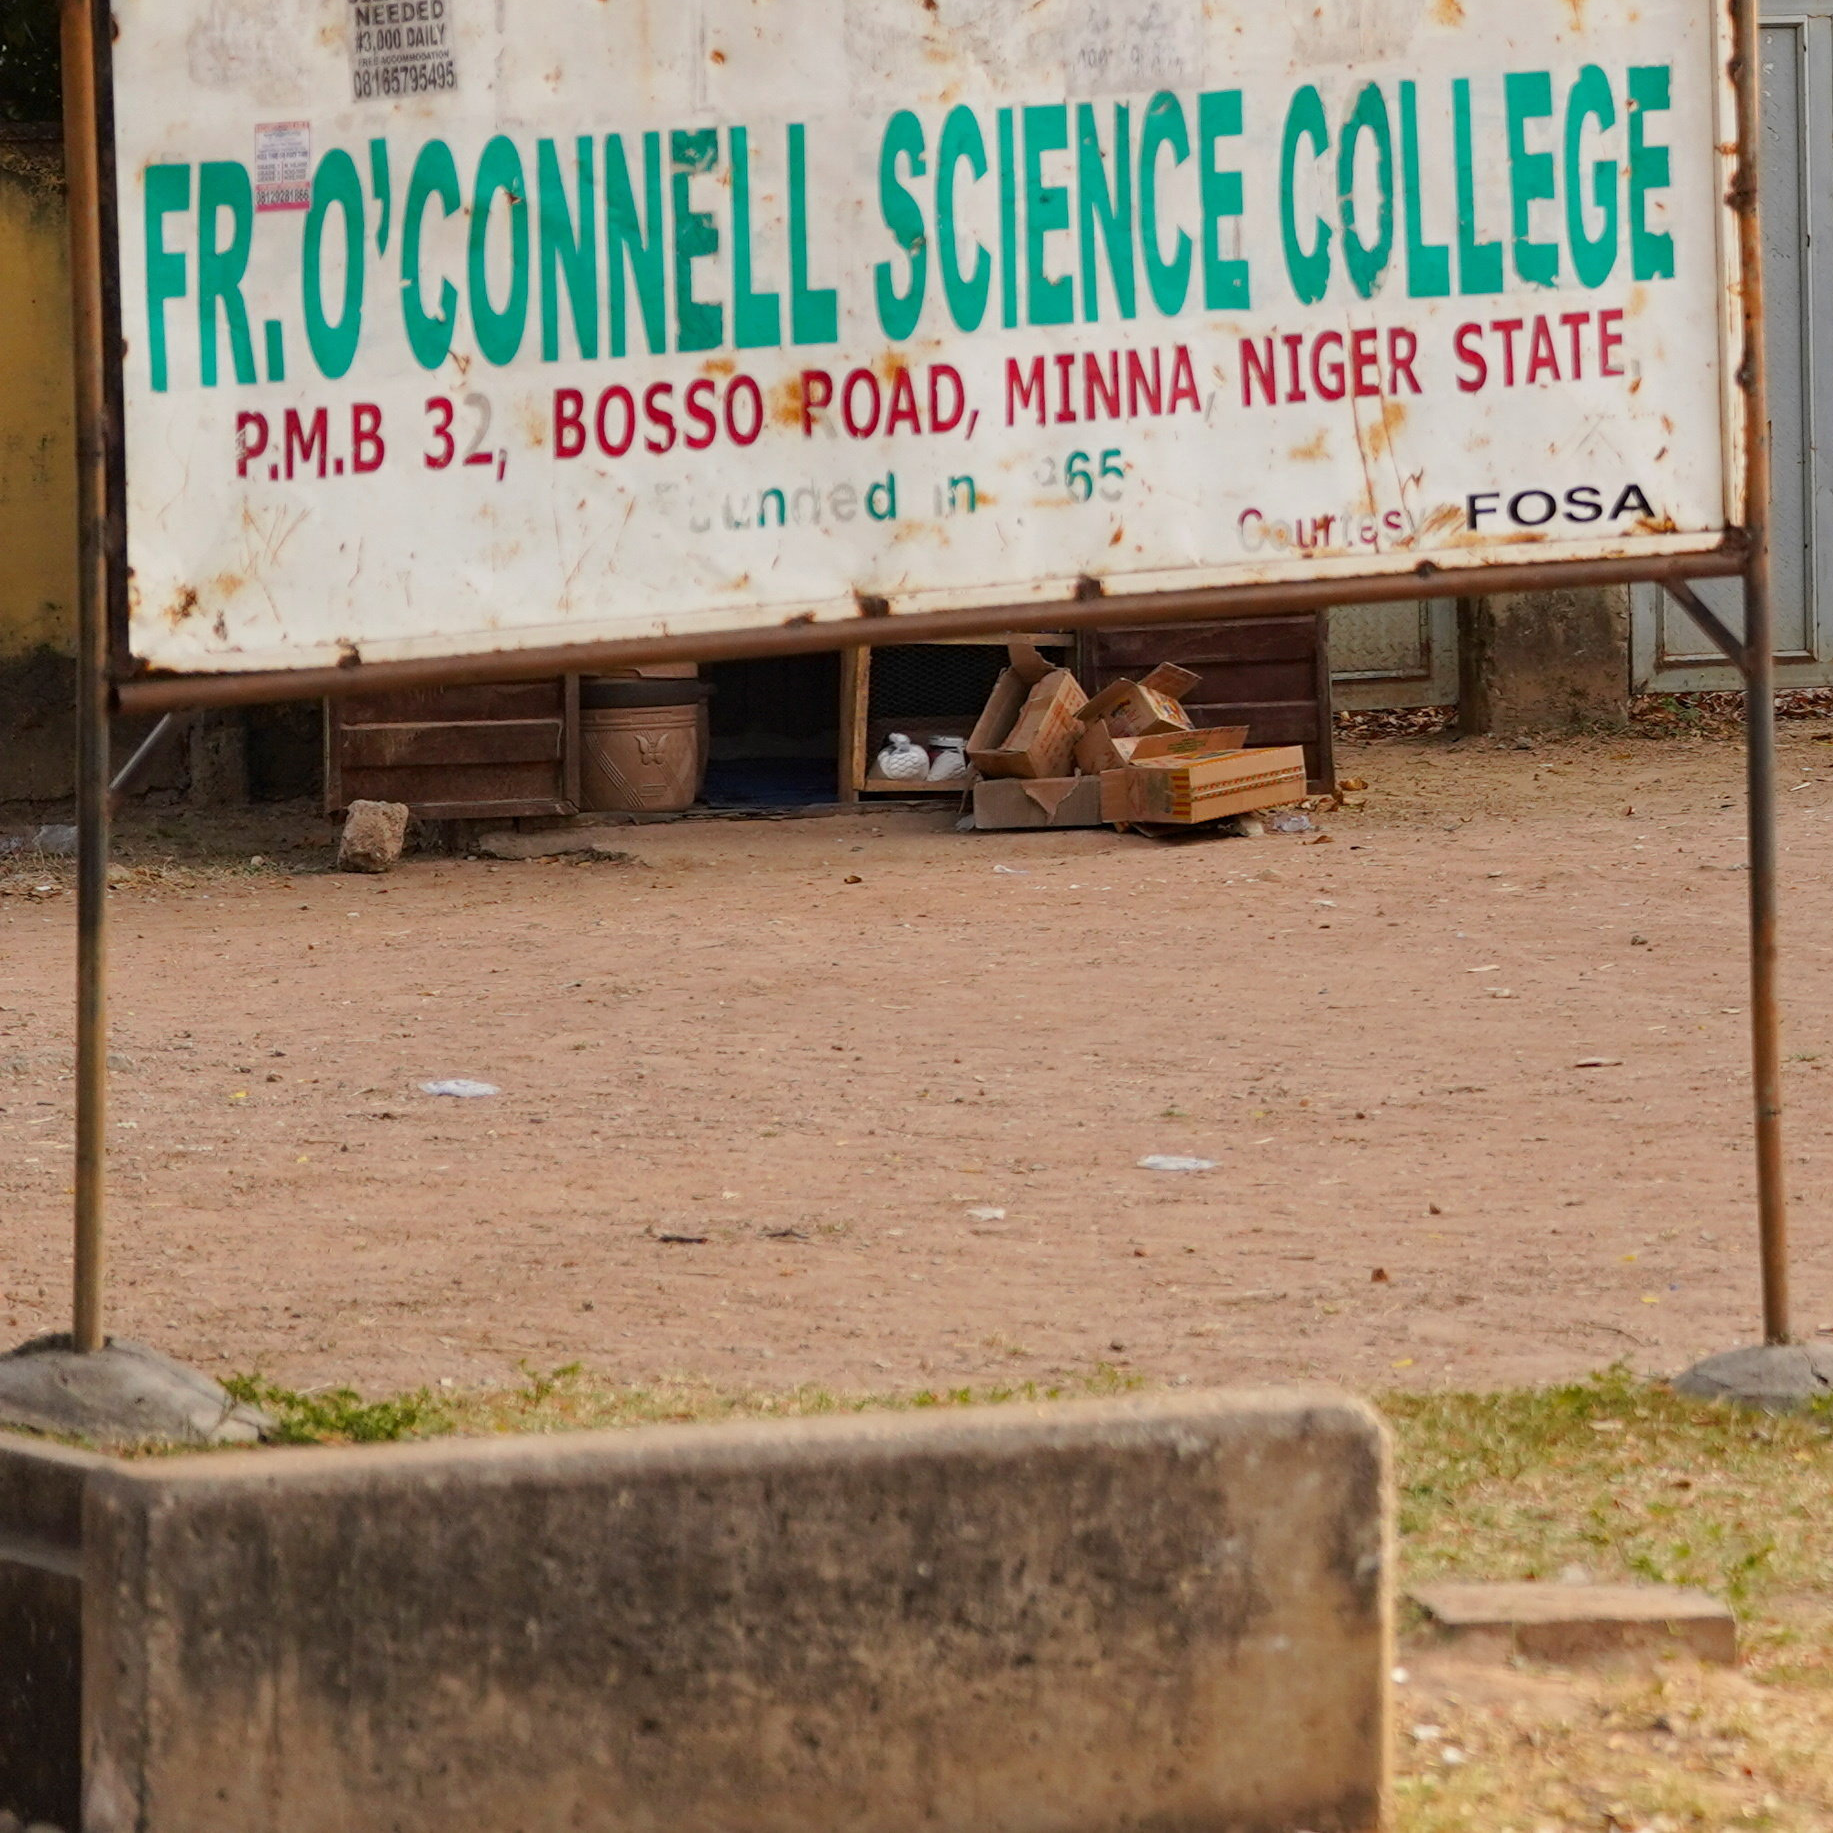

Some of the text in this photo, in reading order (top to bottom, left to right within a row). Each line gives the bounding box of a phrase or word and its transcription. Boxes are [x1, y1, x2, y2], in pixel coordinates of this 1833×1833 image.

[355, 0, 444, 26] NEEDED
[407, 23, 444, 47] DAILY
[353, 61, 456, 98] 08165795495
[875, 88, 1251, 343] SCIENCE
[1278, 63, 1676, 307] COLLEGE
[235, 402, 386, 482] P.M.B
[553, 375, 764, 461] BOSSO
[1238, 326, 1424, 409] NIGER
[1466, 483, 1657, 532] FOSA
